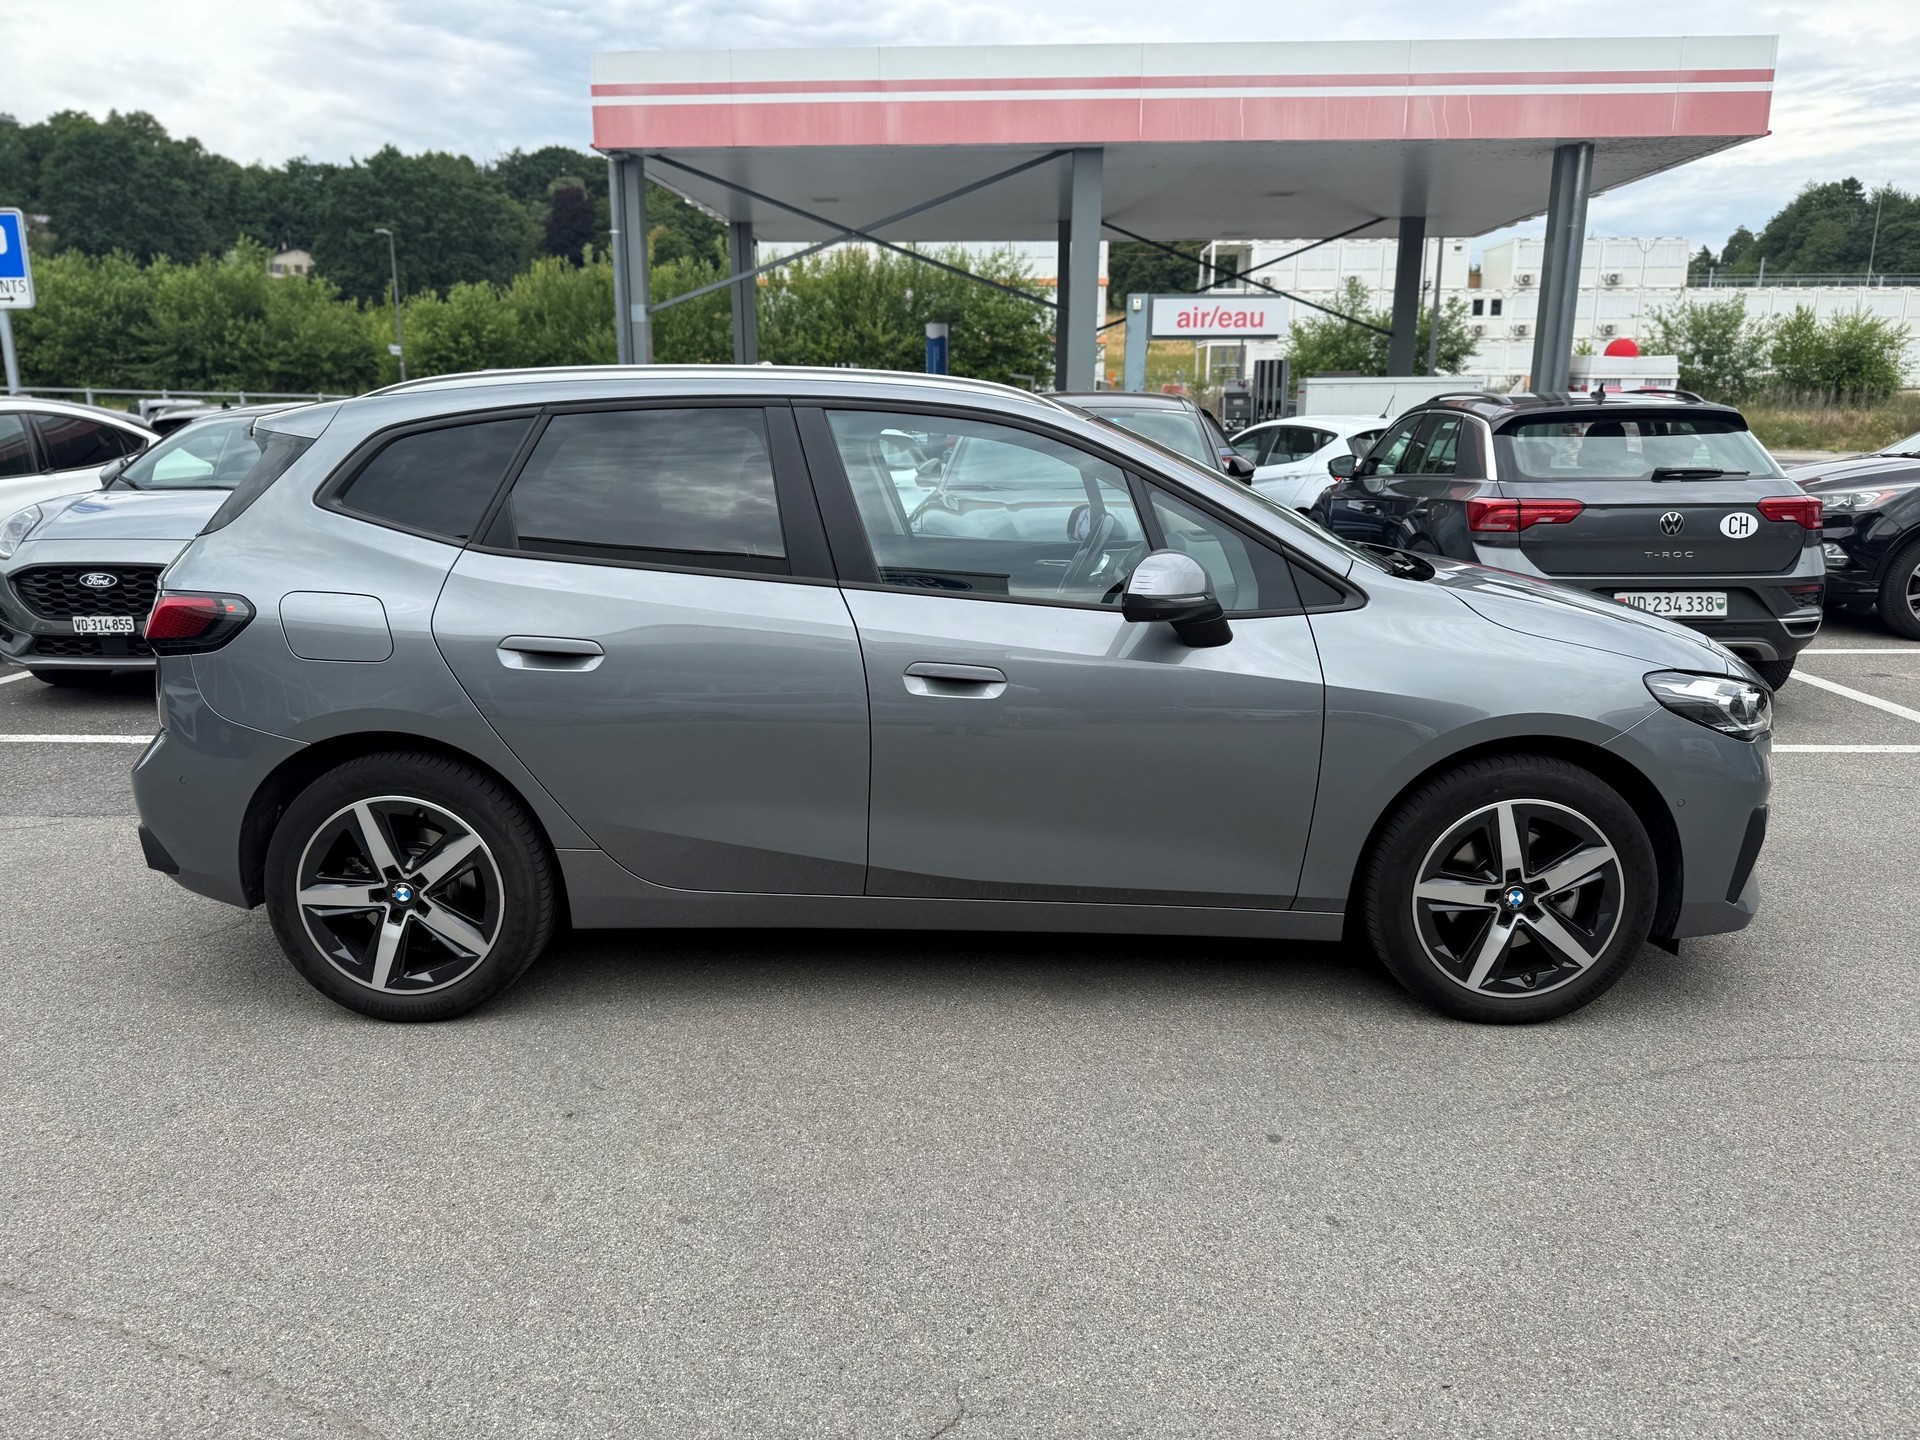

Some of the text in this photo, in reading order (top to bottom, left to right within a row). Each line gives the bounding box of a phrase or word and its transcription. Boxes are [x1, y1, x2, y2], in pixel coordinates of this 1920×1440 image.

[1176, 305, 1264, 328] air/eau
[1728, 516, 1749, 534] CH
[86, 575, 110, 585] Ford
